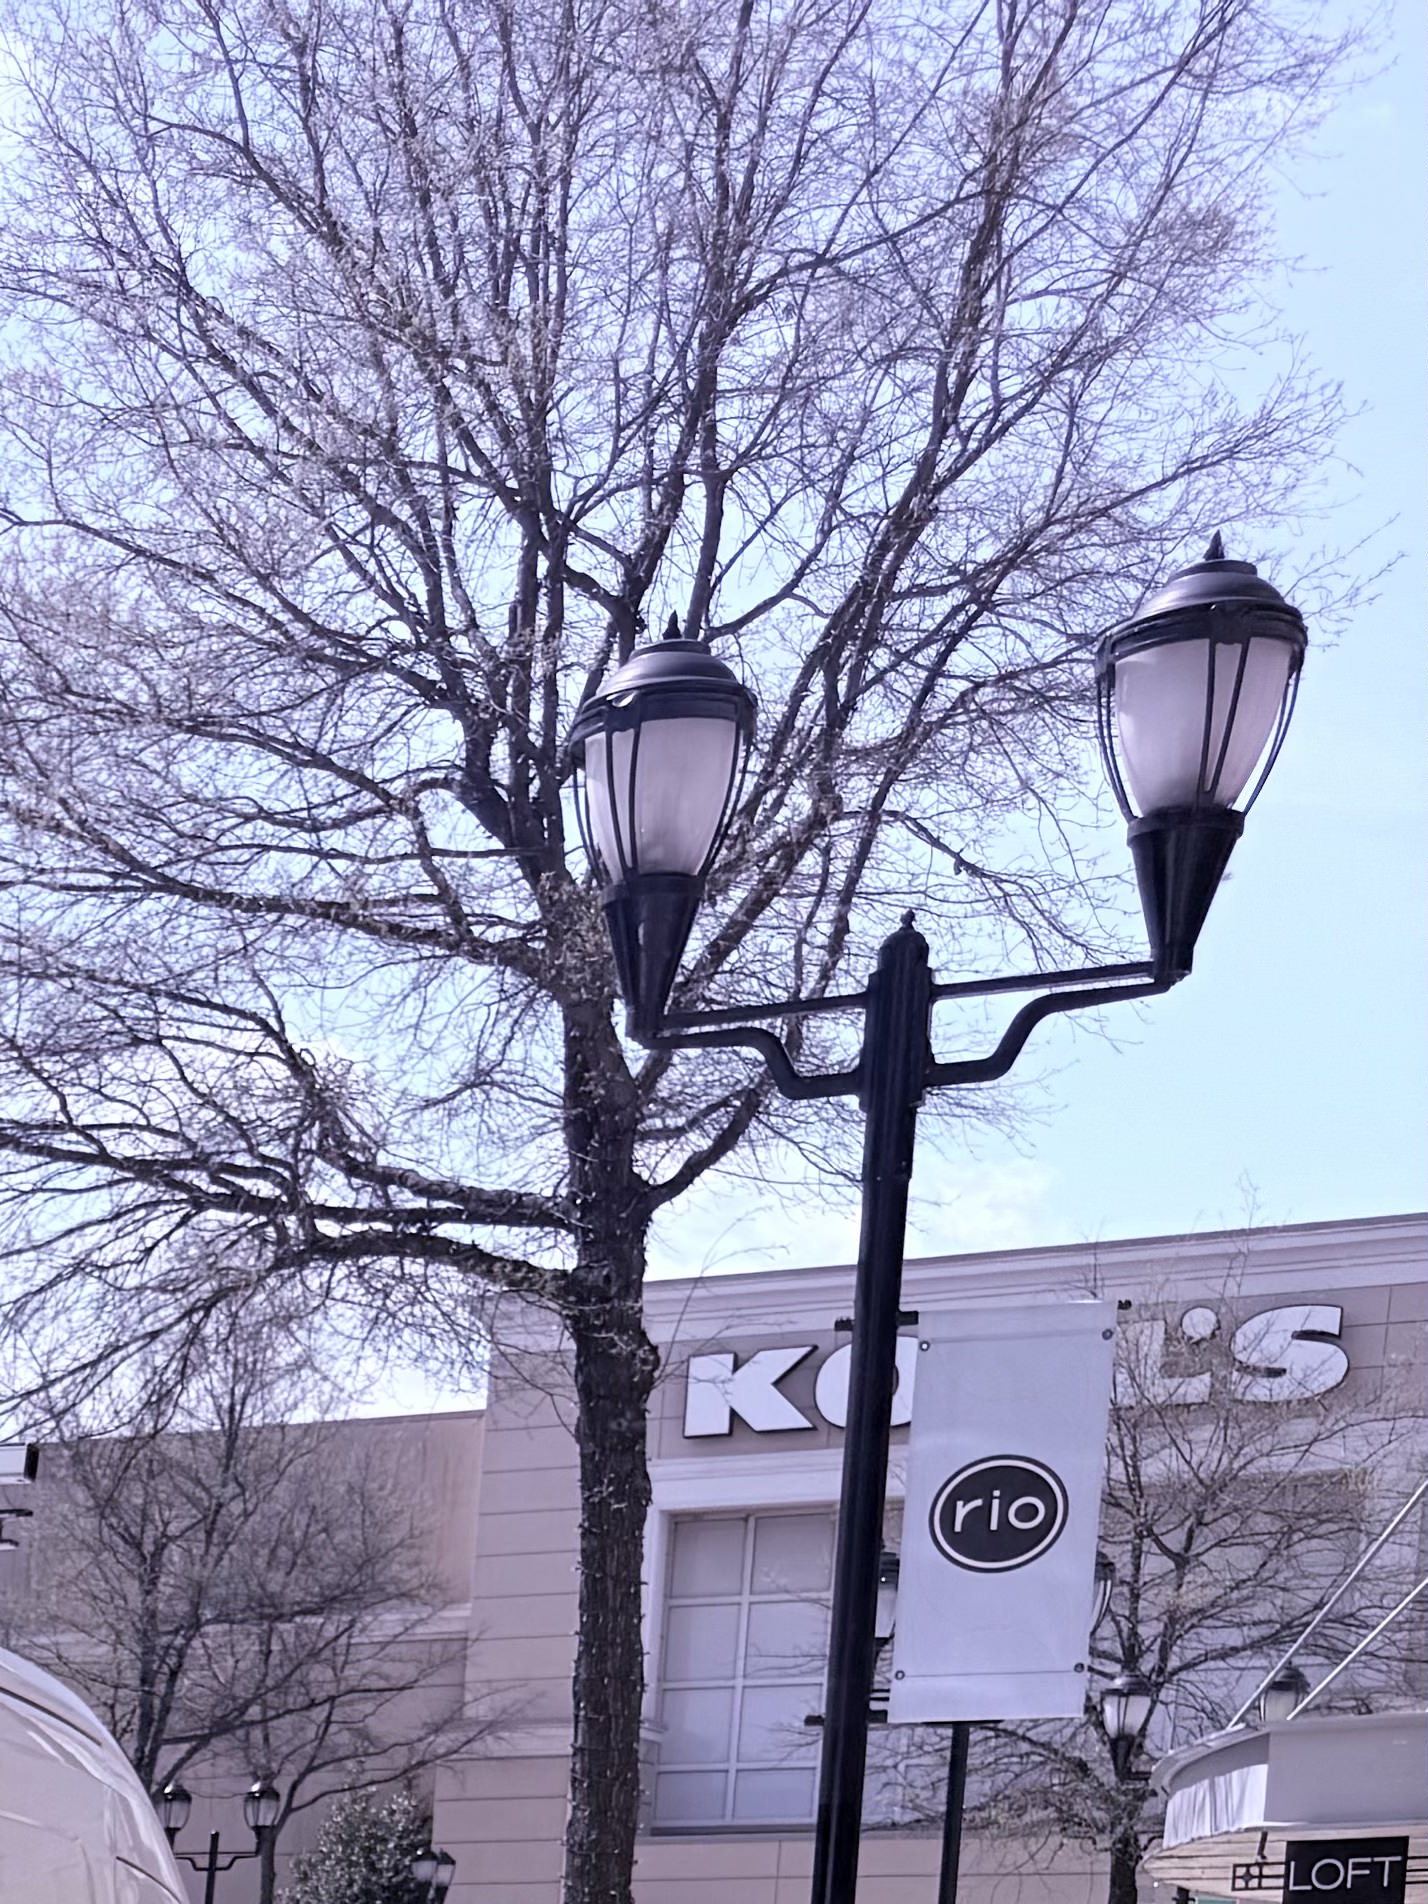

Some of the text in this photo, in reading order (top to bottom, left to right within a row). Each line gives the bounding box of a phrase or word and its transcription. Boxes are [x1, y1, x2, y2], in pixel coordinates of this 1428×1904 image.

[684, 1304, 1349, 1438] KOL'S
[954, 1490, 1045, 1532] rio
[1289, 1856, 1402, 1891] LOFT
